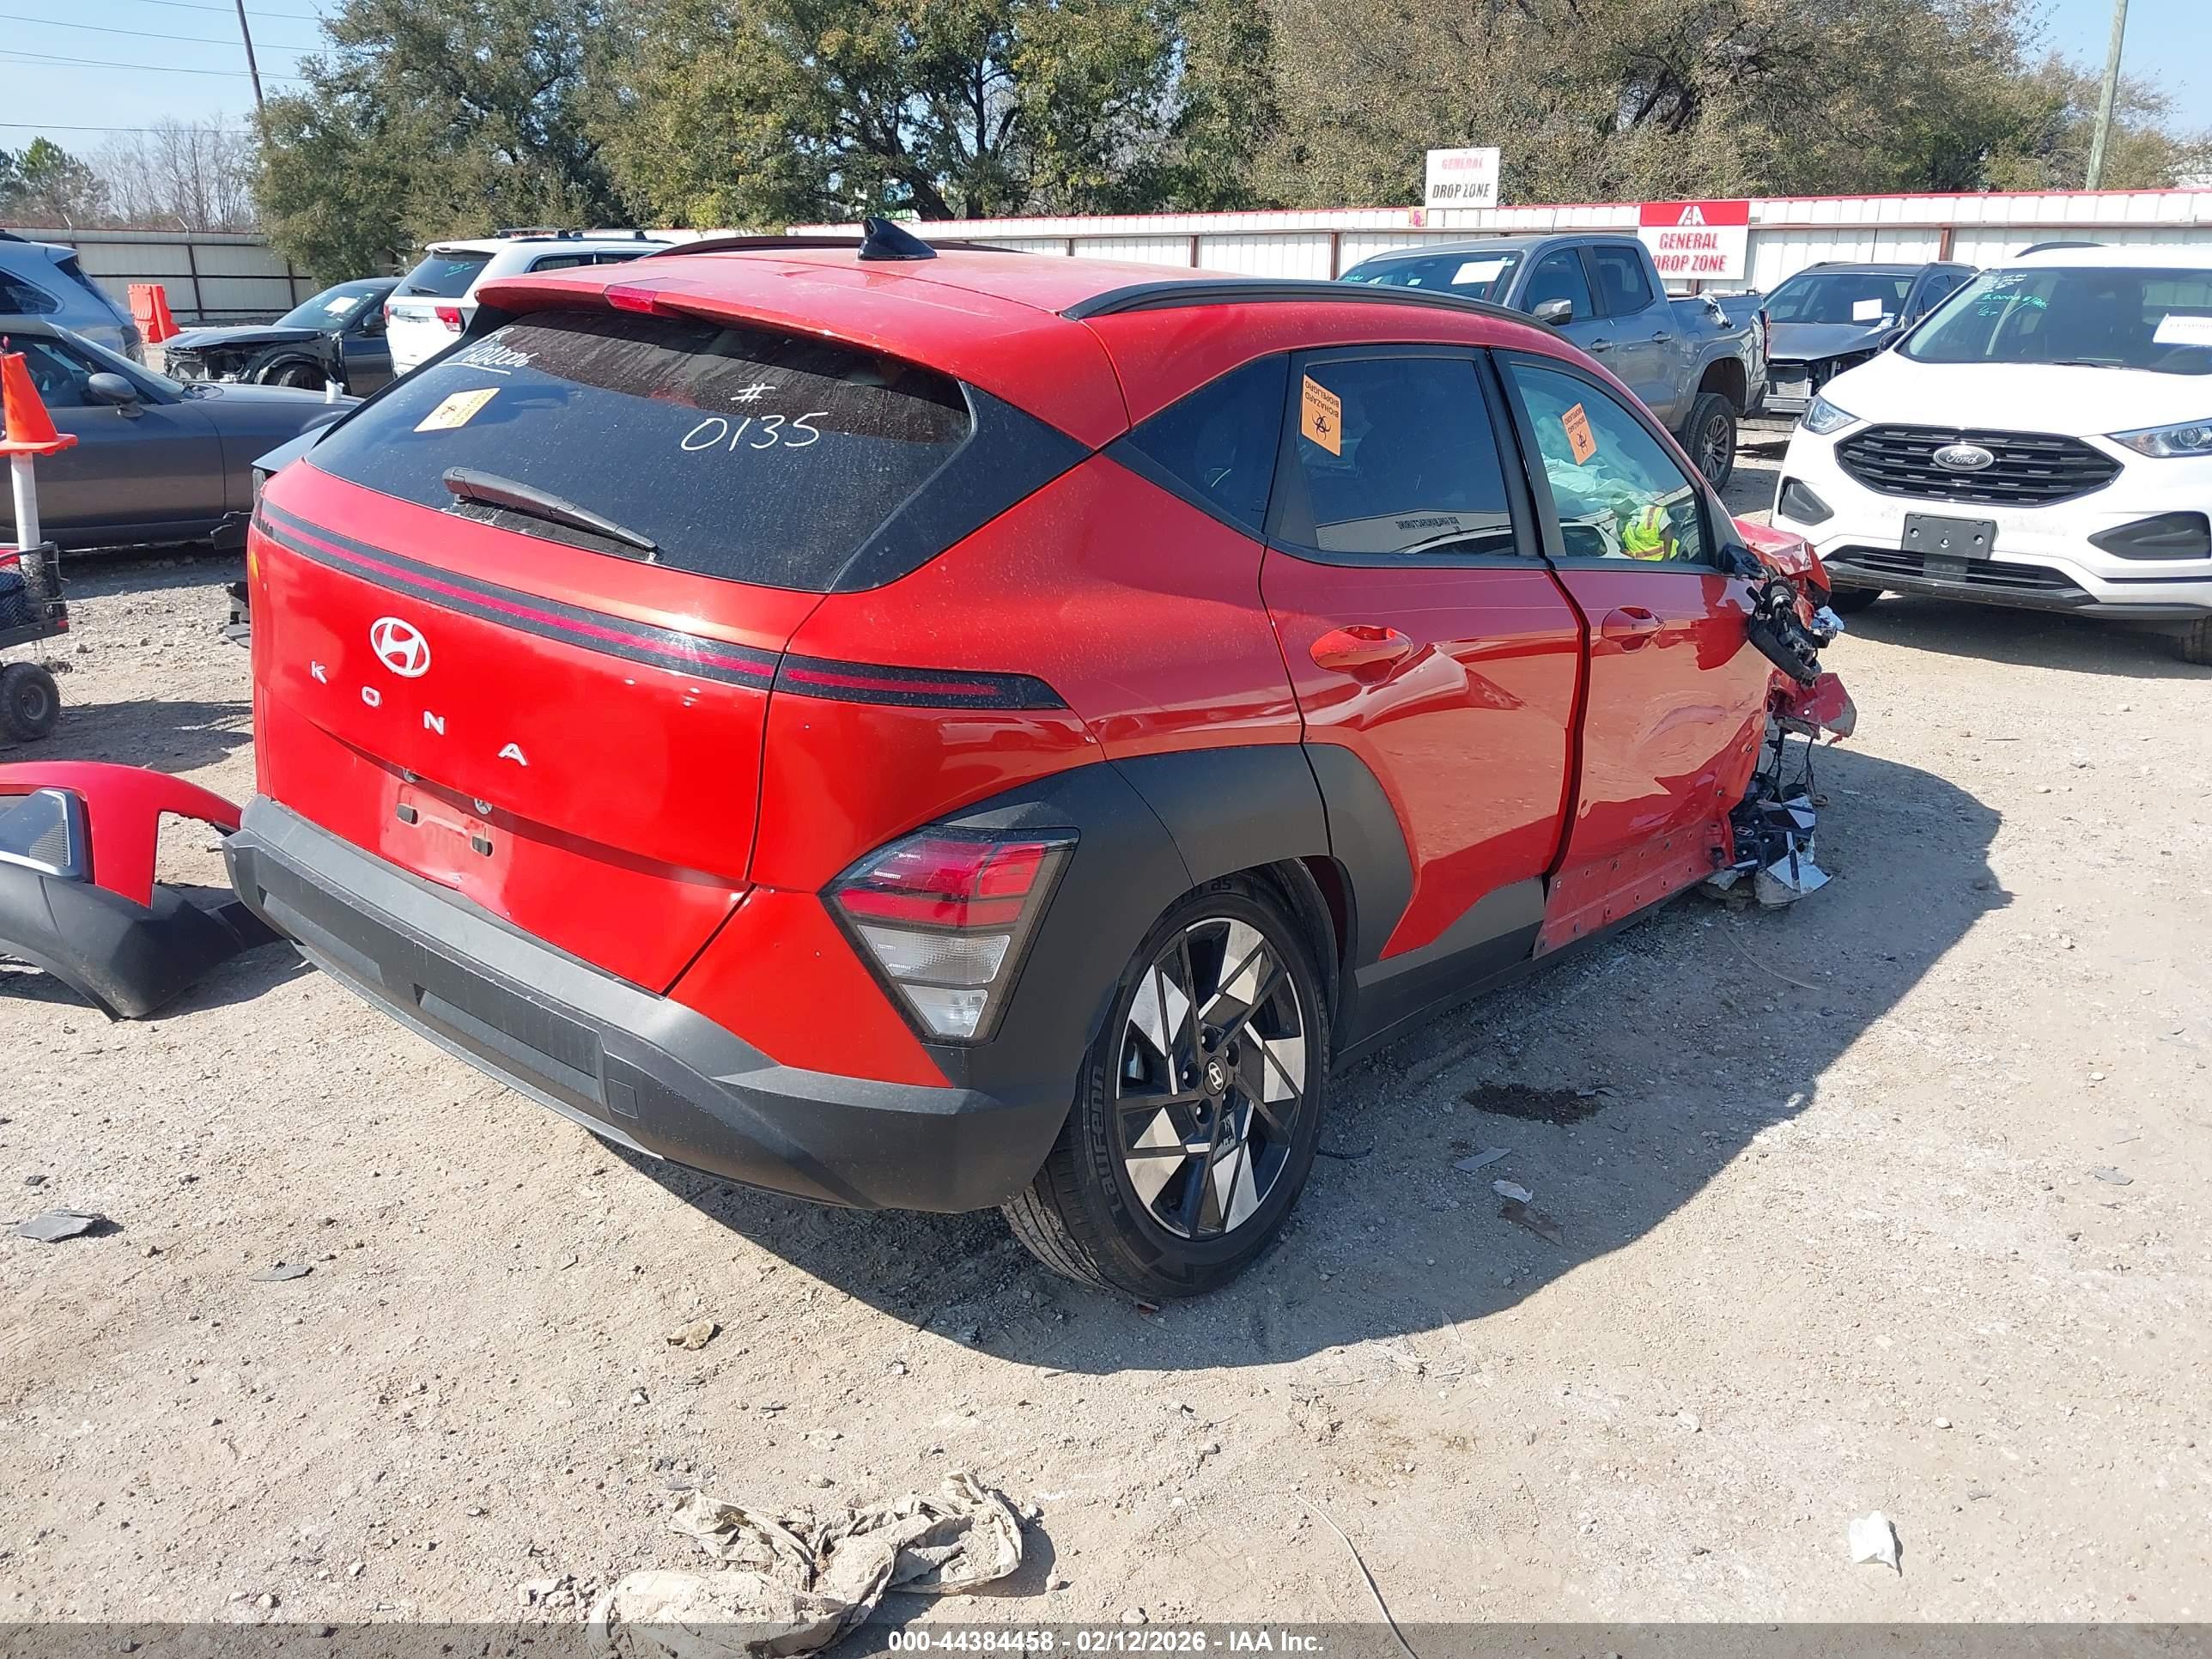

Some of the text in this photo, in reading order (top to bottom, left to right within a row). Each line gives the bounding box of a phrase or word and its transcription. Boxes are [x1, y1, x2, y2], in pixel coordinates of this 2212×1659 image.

[1441, 157, 1485, 171] GENERAL
[1431, 183, 1492, 199] DROP ZONE
[1659, 232, 1719, 251] GENERAL
[1653, 254, 1728, 273] DROP ZONE
[730, 382, 777, 404] #
[1304, 380, 1340, 409] BIOPELIGRO
[1304, 391, 1340, 418] BIOHAZARD
[680, 411, 830, 452] 0135
[1945, 448, 1979, 465] Ford
[310, 659, 529, 767] KONA
